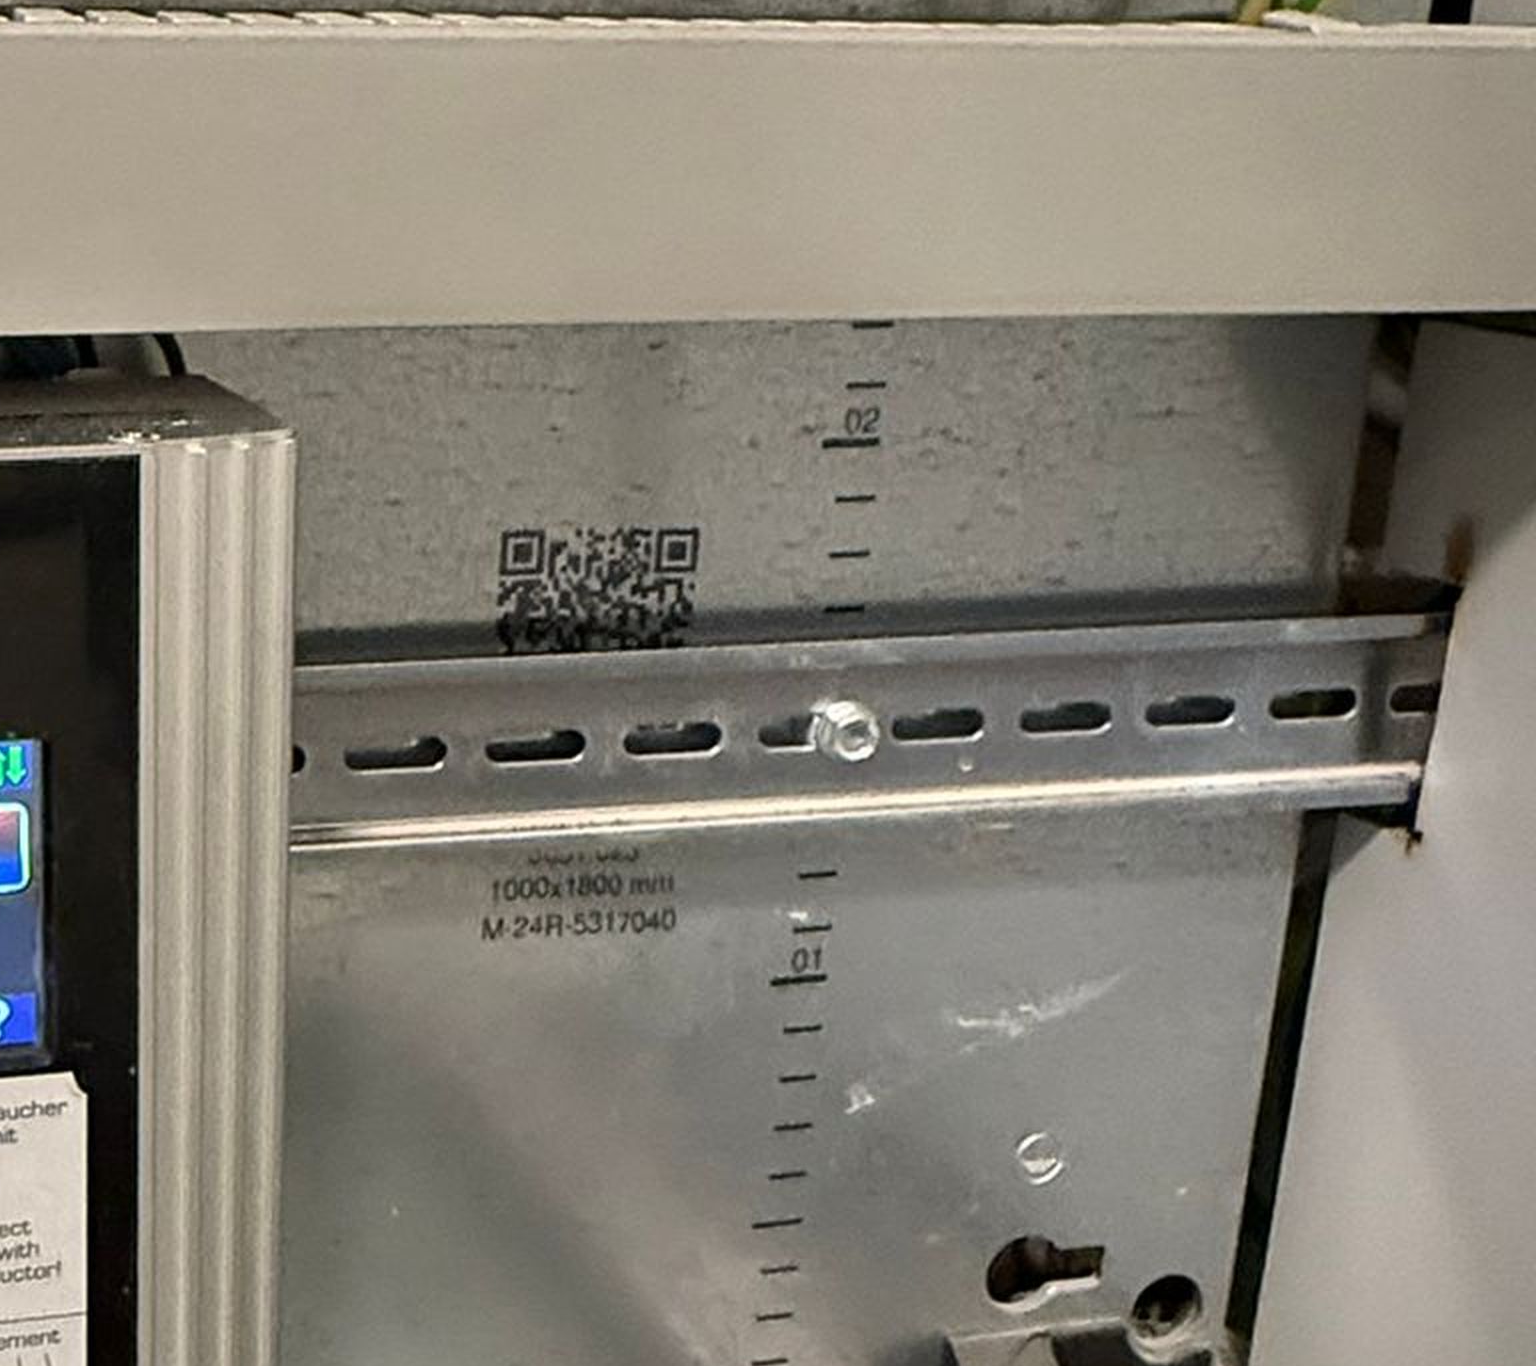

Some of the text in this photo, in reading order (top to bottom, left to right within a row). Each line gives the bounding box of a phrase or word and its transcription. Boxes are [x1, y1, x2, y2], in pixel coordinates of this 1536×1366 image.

[844, 406, 881, 436] 02
[491, 875, 623, 902] 1000x1800
[789, 947, 823, 973] 01
